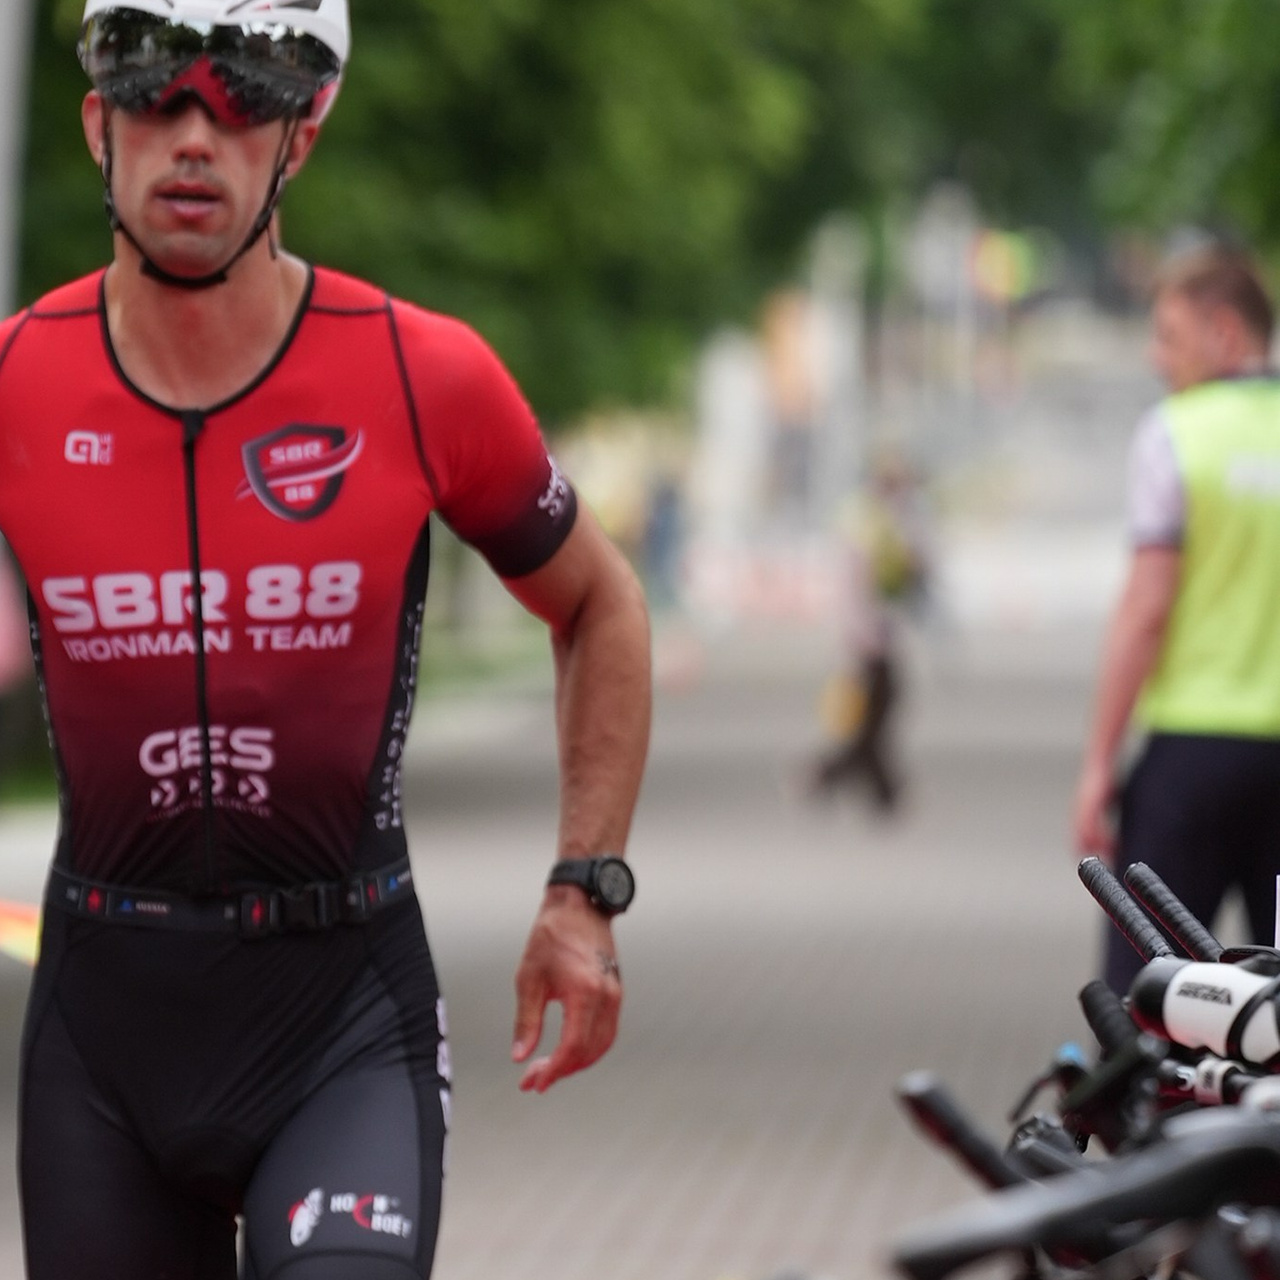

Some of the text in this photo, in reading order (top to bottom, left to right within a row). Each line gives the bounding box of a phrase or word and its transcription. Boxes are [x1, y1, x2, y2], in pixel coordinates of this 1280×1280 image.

[270, 440, 323, 464] SBR
[42, 561, 363, 634] SBR 88
[64, 620, 354, 662] IRONMAN TEAM
[138, 725, 276, 777] GES
